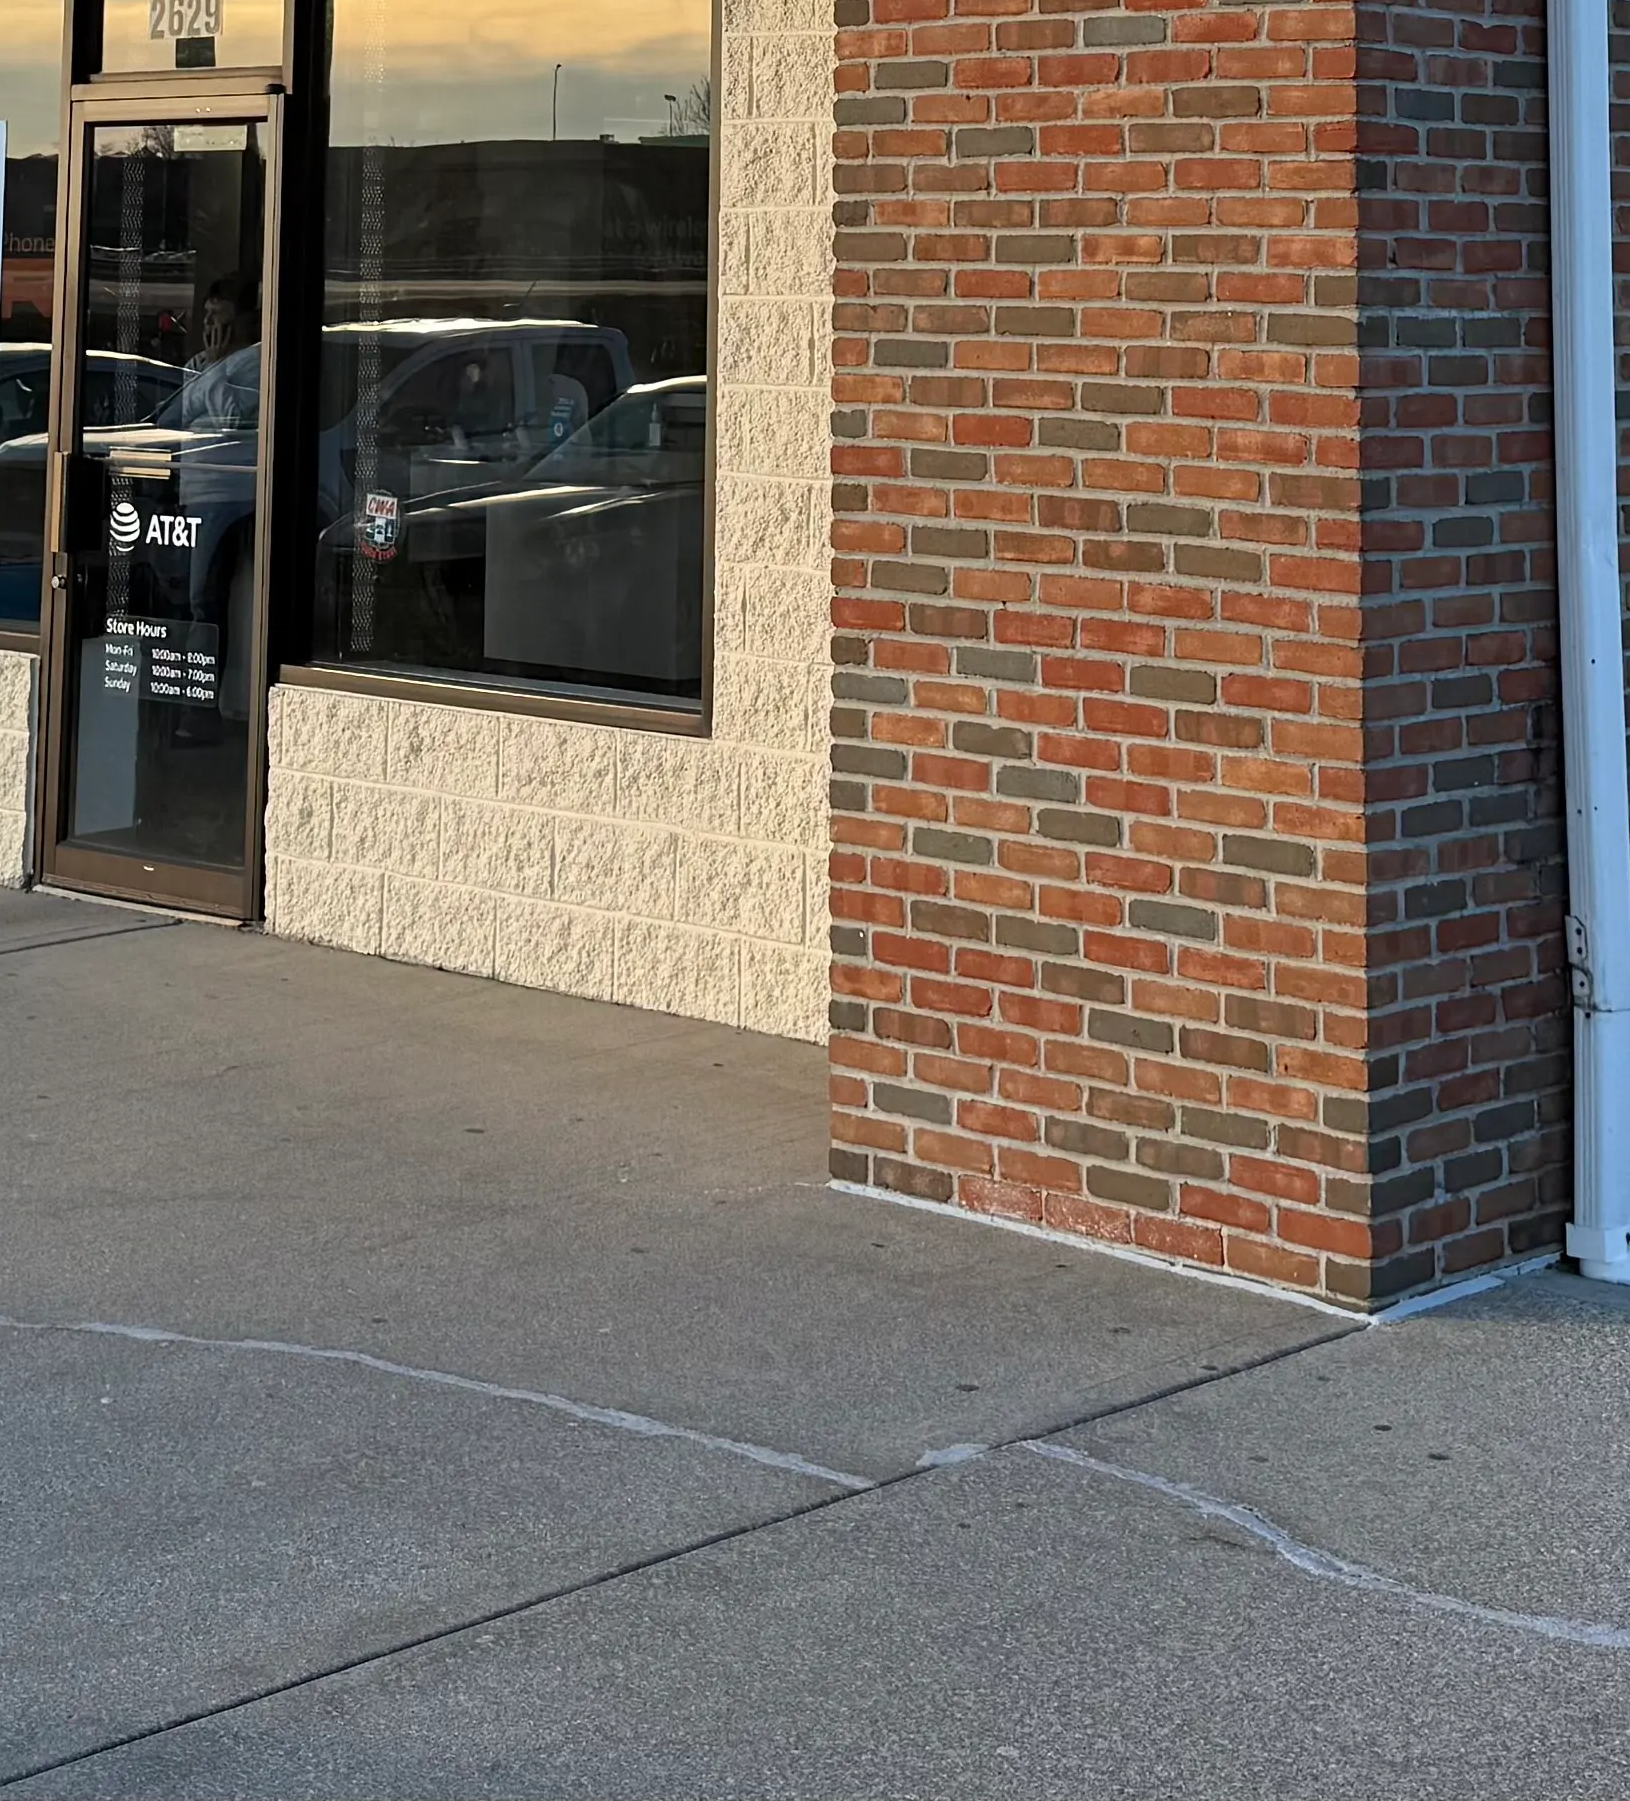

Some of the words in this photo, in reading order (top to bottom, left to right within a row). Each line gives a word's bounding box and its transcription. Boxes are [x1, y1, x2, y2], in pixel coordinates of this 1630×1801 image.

[145, 514, 202, 548] AT&T
[106, 617, 135, 635] Store
[136, 620, 167, 638] Hours
[105, 659, 138, 676] Saturday
[104, 676, 131, 693] Sunday
